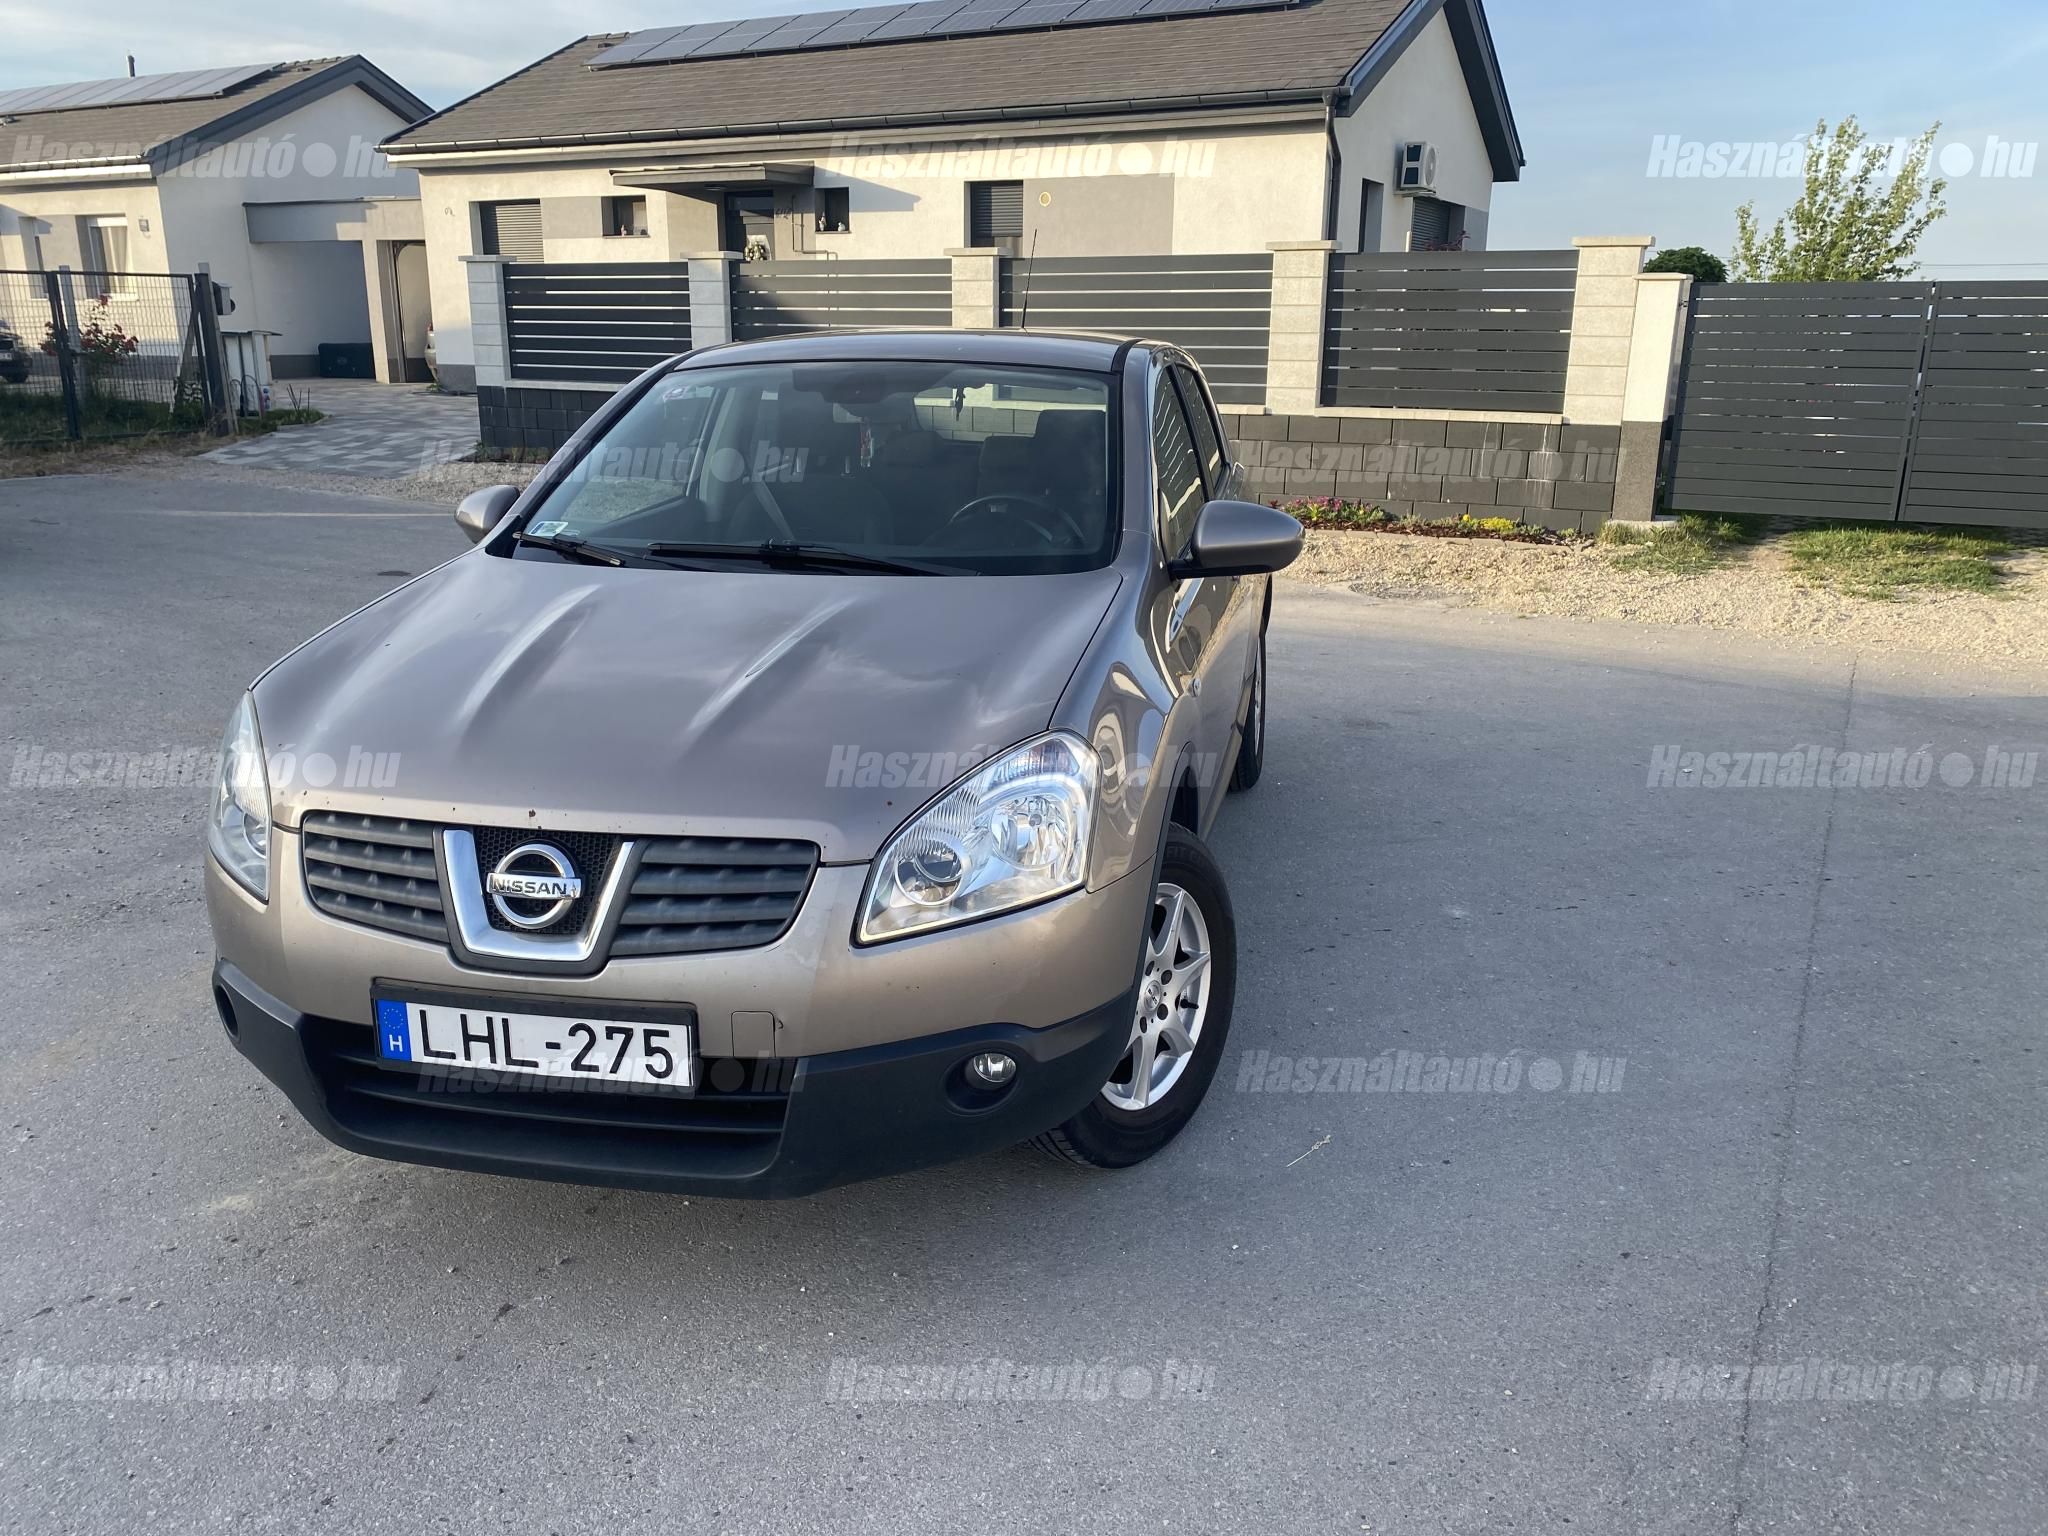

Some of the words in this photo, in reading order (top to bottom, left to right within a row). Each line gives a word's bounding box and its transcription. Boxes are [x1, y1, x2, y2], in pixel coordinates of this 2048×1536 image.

[490, 878, 568, 895] NISSAN
[389, 1034, 404, 1052] H
[419, 1009, 674, 1079] LHL-275
